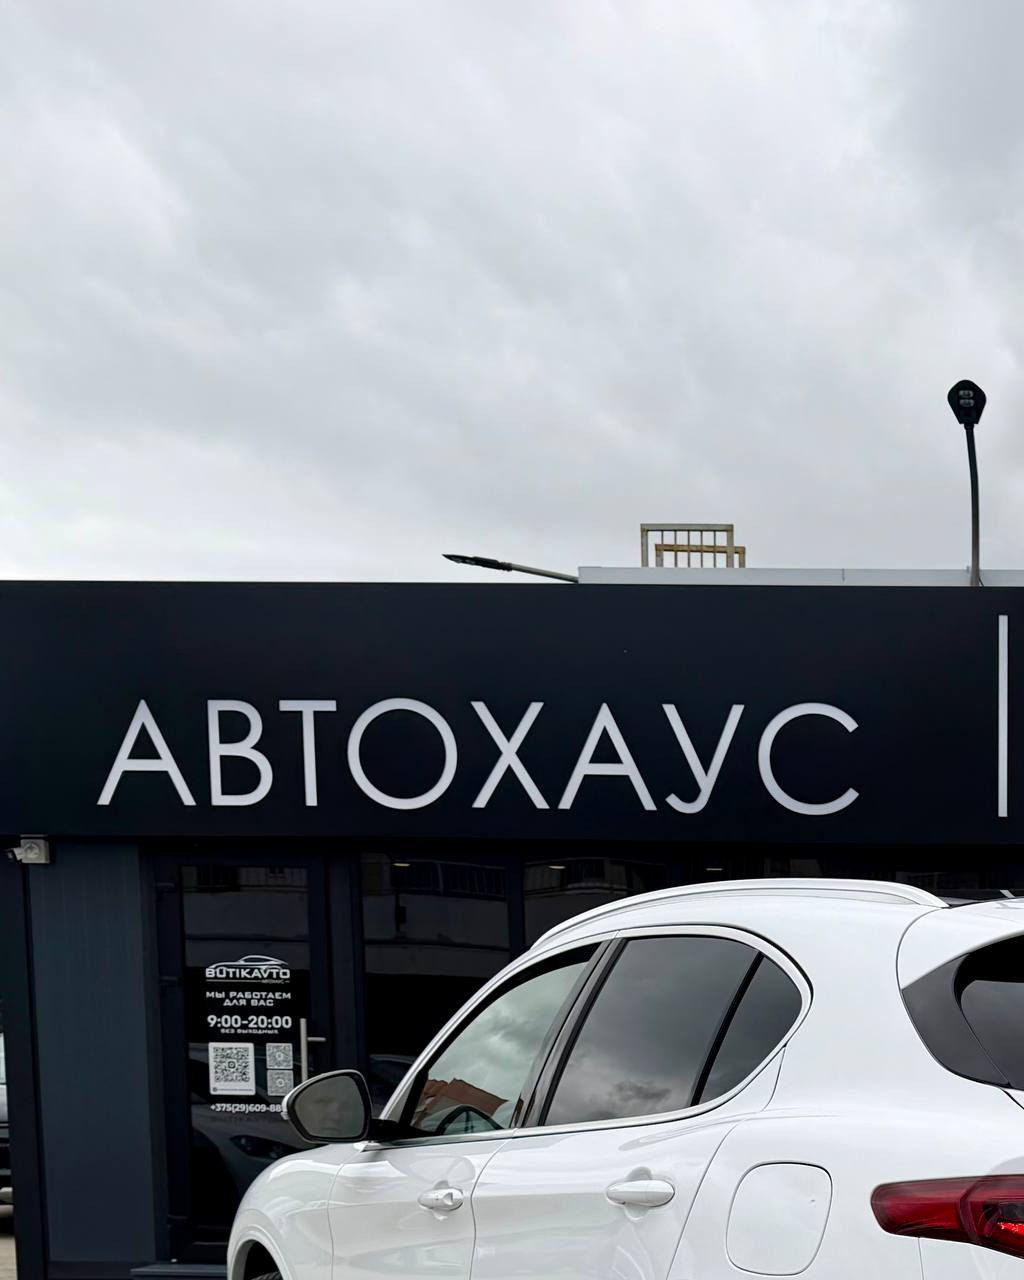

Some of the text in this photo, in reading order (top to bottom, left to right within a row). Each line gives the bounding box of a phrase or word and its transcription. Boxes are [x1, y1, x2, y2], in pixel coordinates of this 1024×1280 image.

[97, 697, 860, 816] АВТОХАУС
[205, 968, 291, 979] BUTIKAVTO
[229, 991, 292, 999] РАБОТАЕМ
[206, 1014, 292, 1029] 9:00-20:00
[210, 1103, 281, 1114] +375(29)609-88
